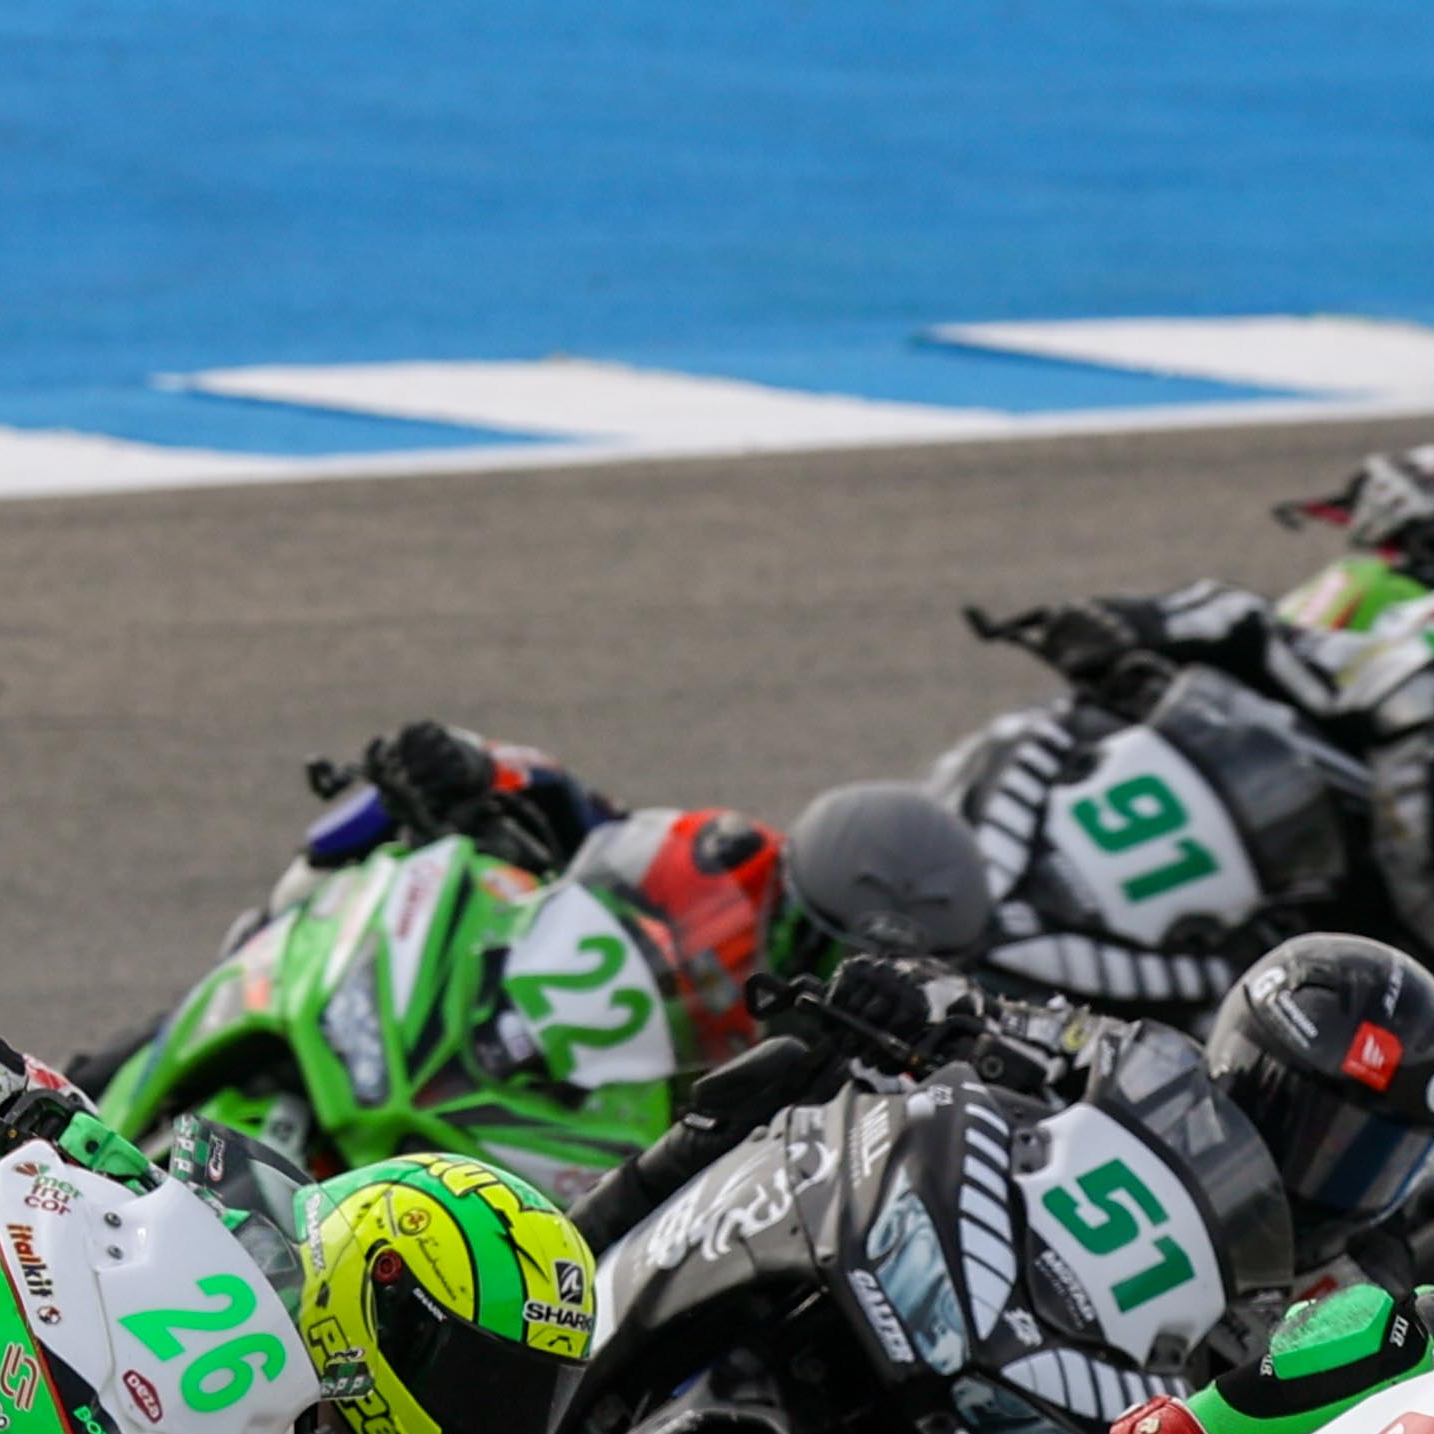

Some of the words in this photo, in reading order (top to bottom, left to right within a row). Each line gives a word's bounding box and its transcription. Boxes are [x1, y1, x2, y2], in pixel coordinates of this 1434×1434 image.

[1072, 772, 1220, 904] 91
[505, 936, 652, 1082] 22
[1041, 1158, 1196, 1314] 51
[119, 1273, 287, 1412] 26
[412, 1288, 446, 1321] SHARK
[524, 1302, 592, 1331] SHARK
[848, 1269, 915, 1364] GALFER
